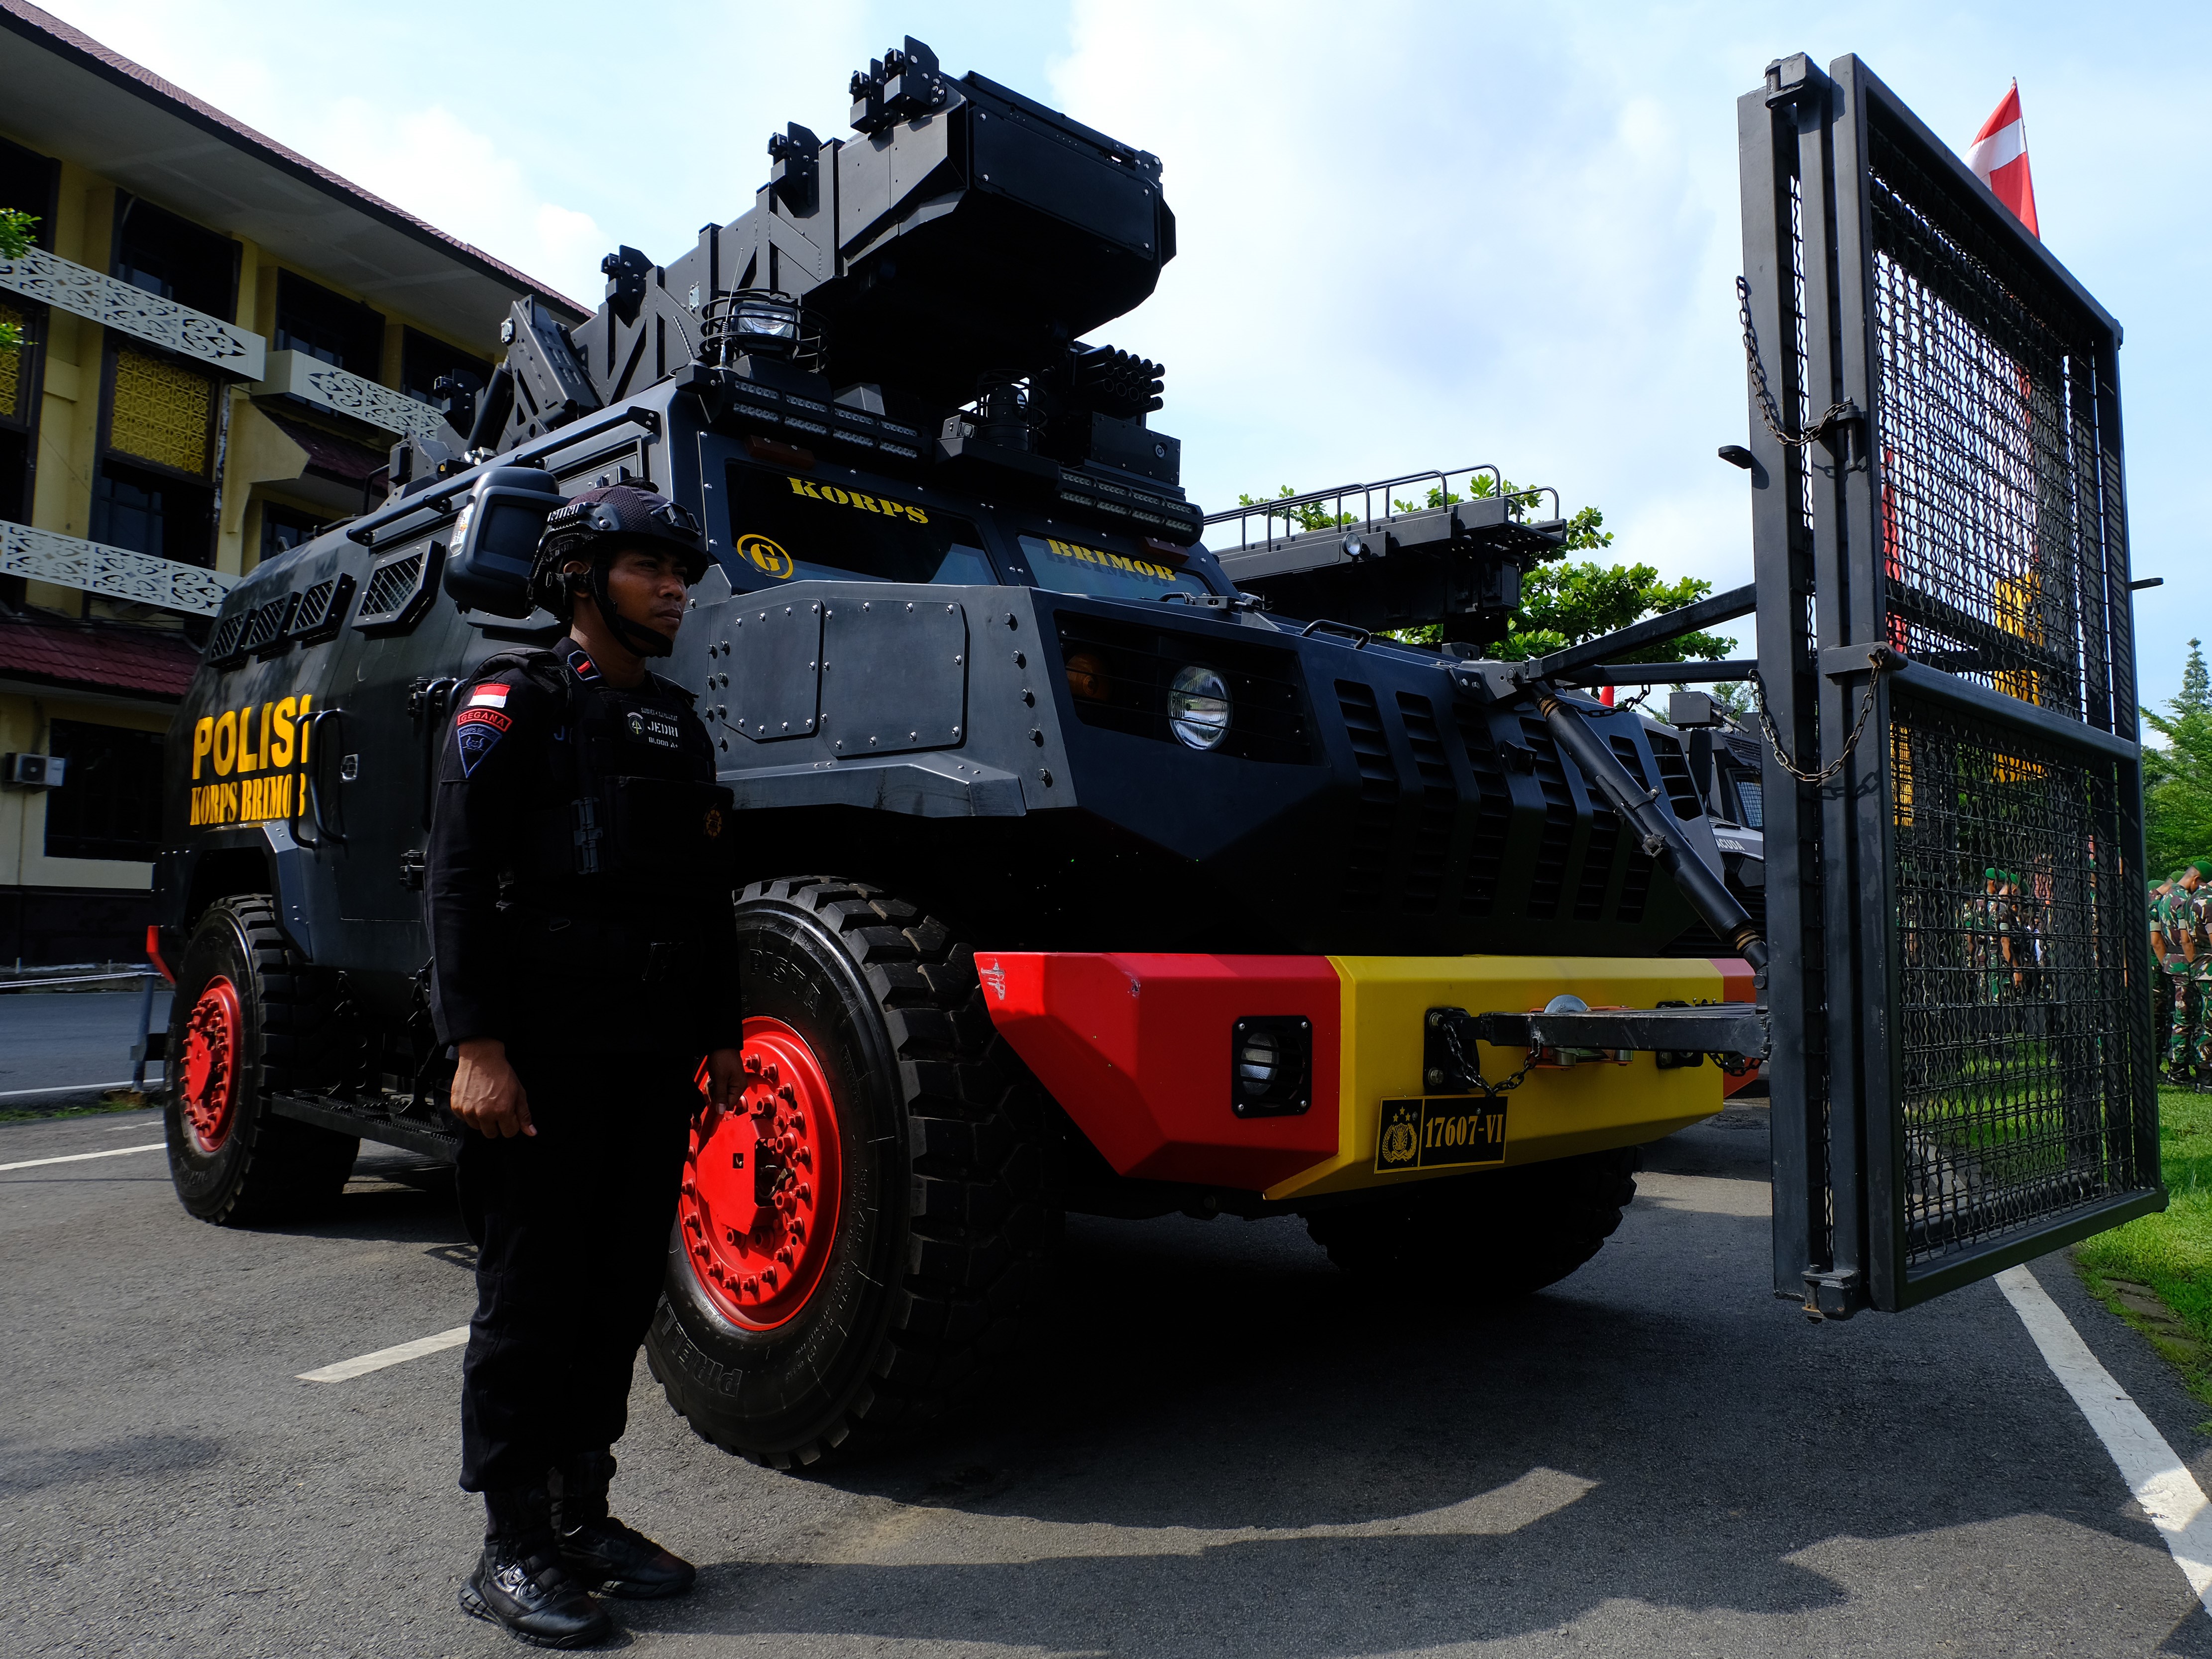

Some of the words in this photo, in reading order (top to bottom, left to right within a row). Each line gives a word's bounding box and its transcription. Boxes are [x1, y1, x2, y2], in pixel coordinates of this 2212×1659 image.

[786, 476, 929, 524] KORPS
[750, 544, 781, 572] G
[1046, 538, 1176, 582] BRIMOB
[460, 711, 505, 727] GEGANA
[647, 721, 678, 738] JEDRI
[192, 694, 313, 780] POLISI
[648, 737, 668, 747] BLOOD
[190, 781, 238, 826] KORPS
[1425, 1113, 1504, 1148] 17607-VI
